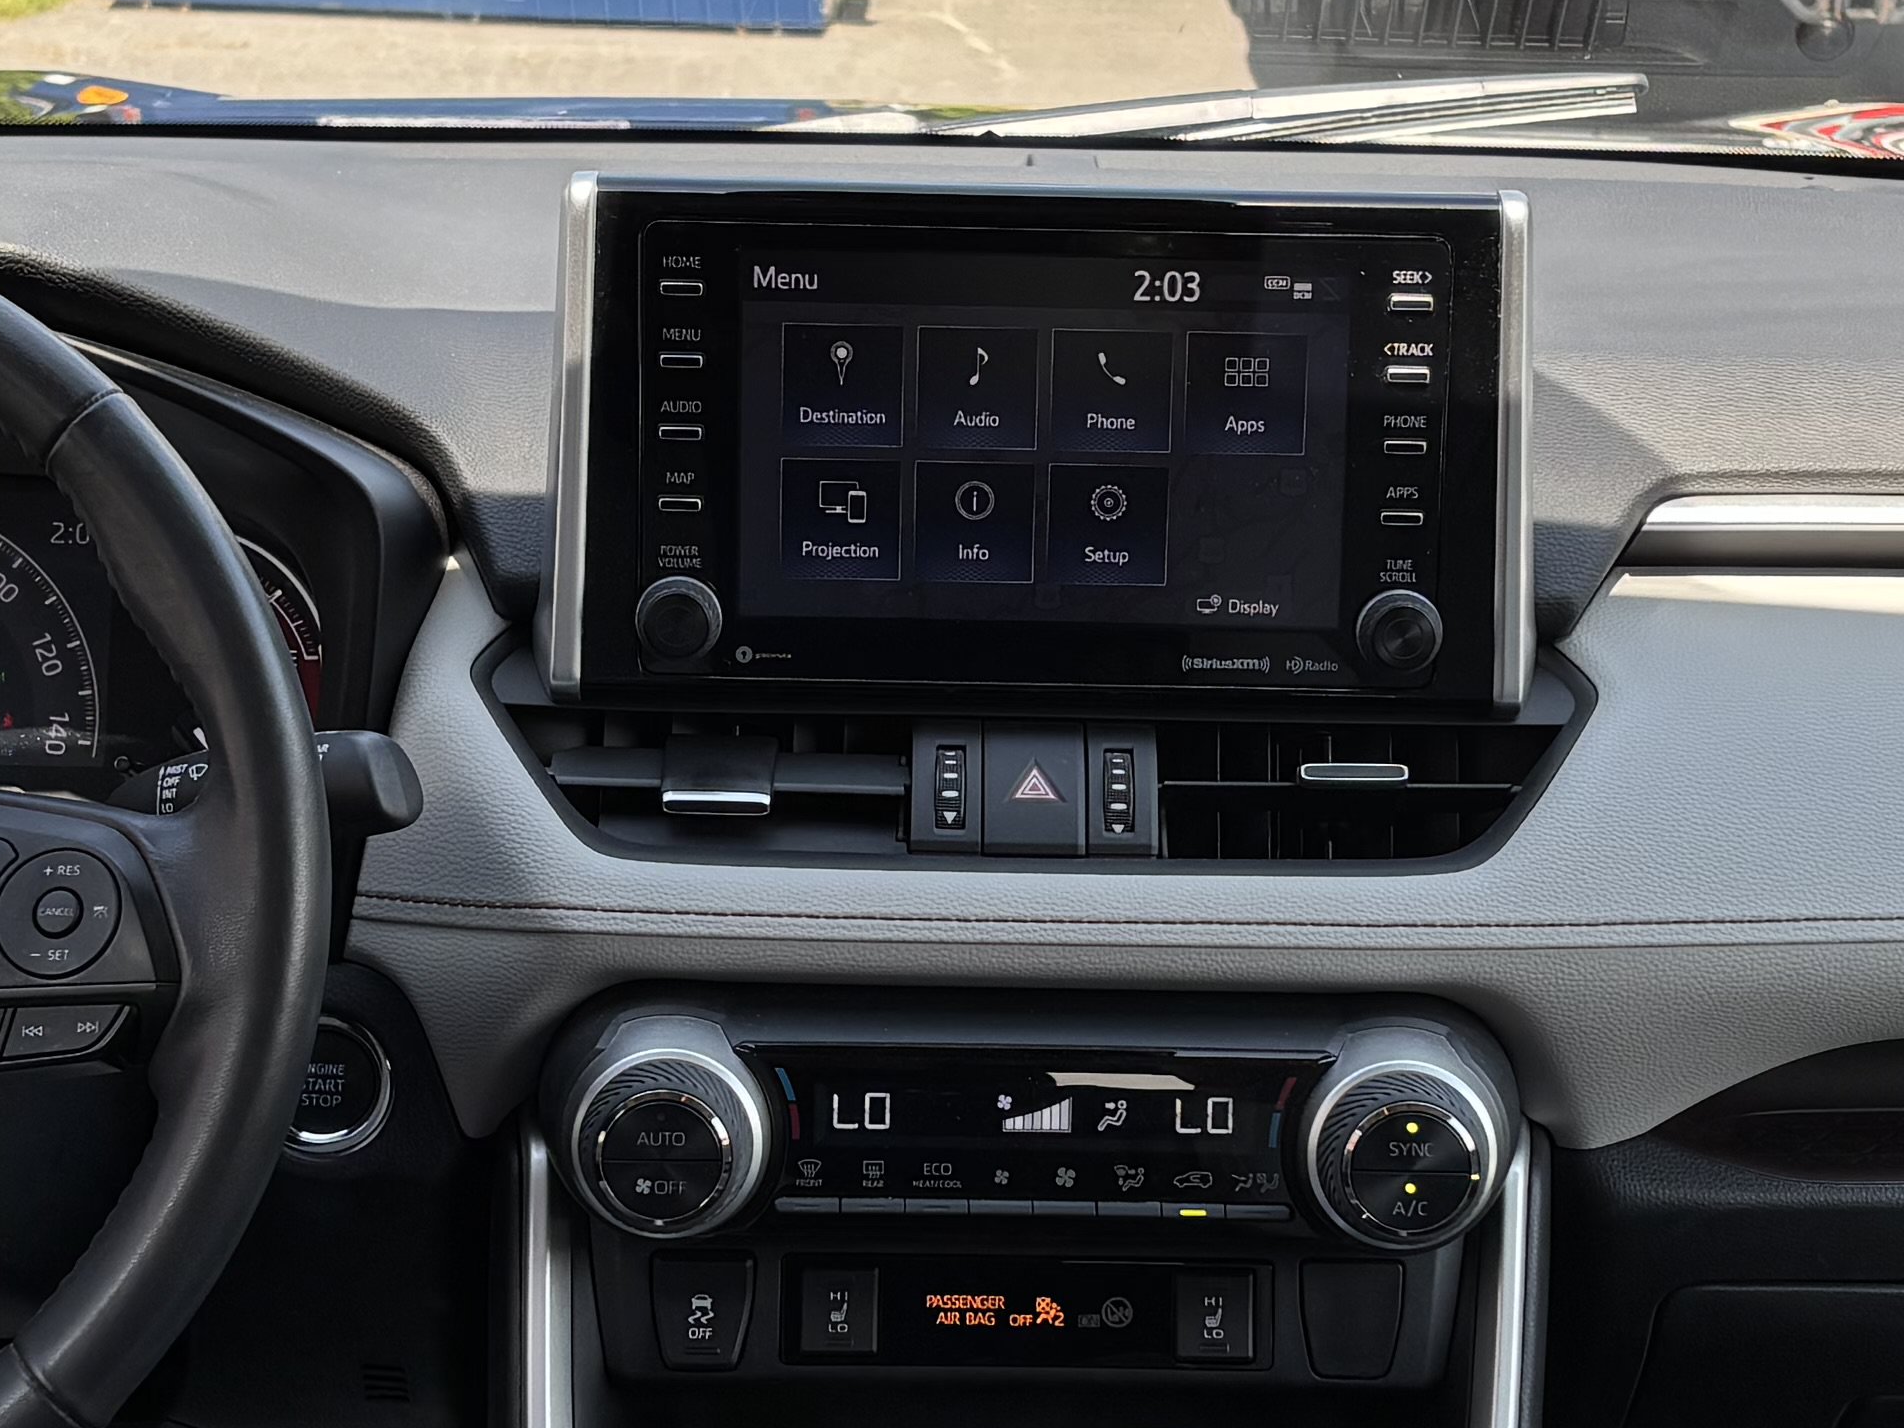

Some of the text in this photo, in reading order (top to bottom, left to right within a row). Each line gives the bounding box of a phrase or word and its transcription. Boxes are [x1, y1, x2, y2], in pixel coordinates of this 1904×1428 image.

[662, 256, 702, 269] HOME
[753, 266, 819, 292] Menu
[1133, 271, 1201, 302] 2:03
[662, 328, 701, 341] MENU
[660, 400, 702, 414] AUDIO
[799, 407, 886, 426] Destination
[953, 411, 1000, 428] Audio
[1086, 413, 1136, 430] Phone
[1384, 415, 1427, 428] PHONE
[1225, 416, 1265, 435] Apps
[666, 472, 695, 485] MAP
[1386, 487, 1419, 500] APPS
[50, 522, 90, 546] 2:0
[660, 545, 699, 556] POWER
[801, 541, 879, 562] Projection
[958, 544, 990, 561] Info
[1084, 547, 1129, 566] Setup
[658, 557, 702, 569] VOLUME
[1386, 559, 1413, 570] TUNE
[1379, 572, 1417, 583] SCROLL
[1228, 599, 1279, 618] Display
[32, 633, 63, 677] 120
[1305, 659, 1339, 673] Radio
[45, 713, 70, 756] 140
[163, 776, 181, 788] OFF
[39, 907, 75, 917] CANCEL
[307, 1063, 345, 1075] NGINE
[304, 1078, 345, 1091] TART
[301, 1094, 342, 1107] STOP
[833, 1092, 890, 1130] LO
[1174, 1097, 1233, 1137] LO
[636, 1132, 686, 1147] AUTO
[1388, 1139, 1436, 1160] SYNC
[923, 1163, 952, 1176] ECO
[654, 1182, 687, 1196] OFF
[1392, 1197, 1429, 1219] A/C
[830, 1291, 849, 1301] HI
[926, 1294, 1005, 1311] PASSENGER
[1204, 1296, 1222, 1307] HI
[937, 1311, 996, 1328] AIR BAG
[1009, 1314, 1033, 1328] OFF
[688, 1326, 714, 1341] OFF
[828, 1323, 849, 1334] LO
[1203, 1328, 1223, 1340] LO
